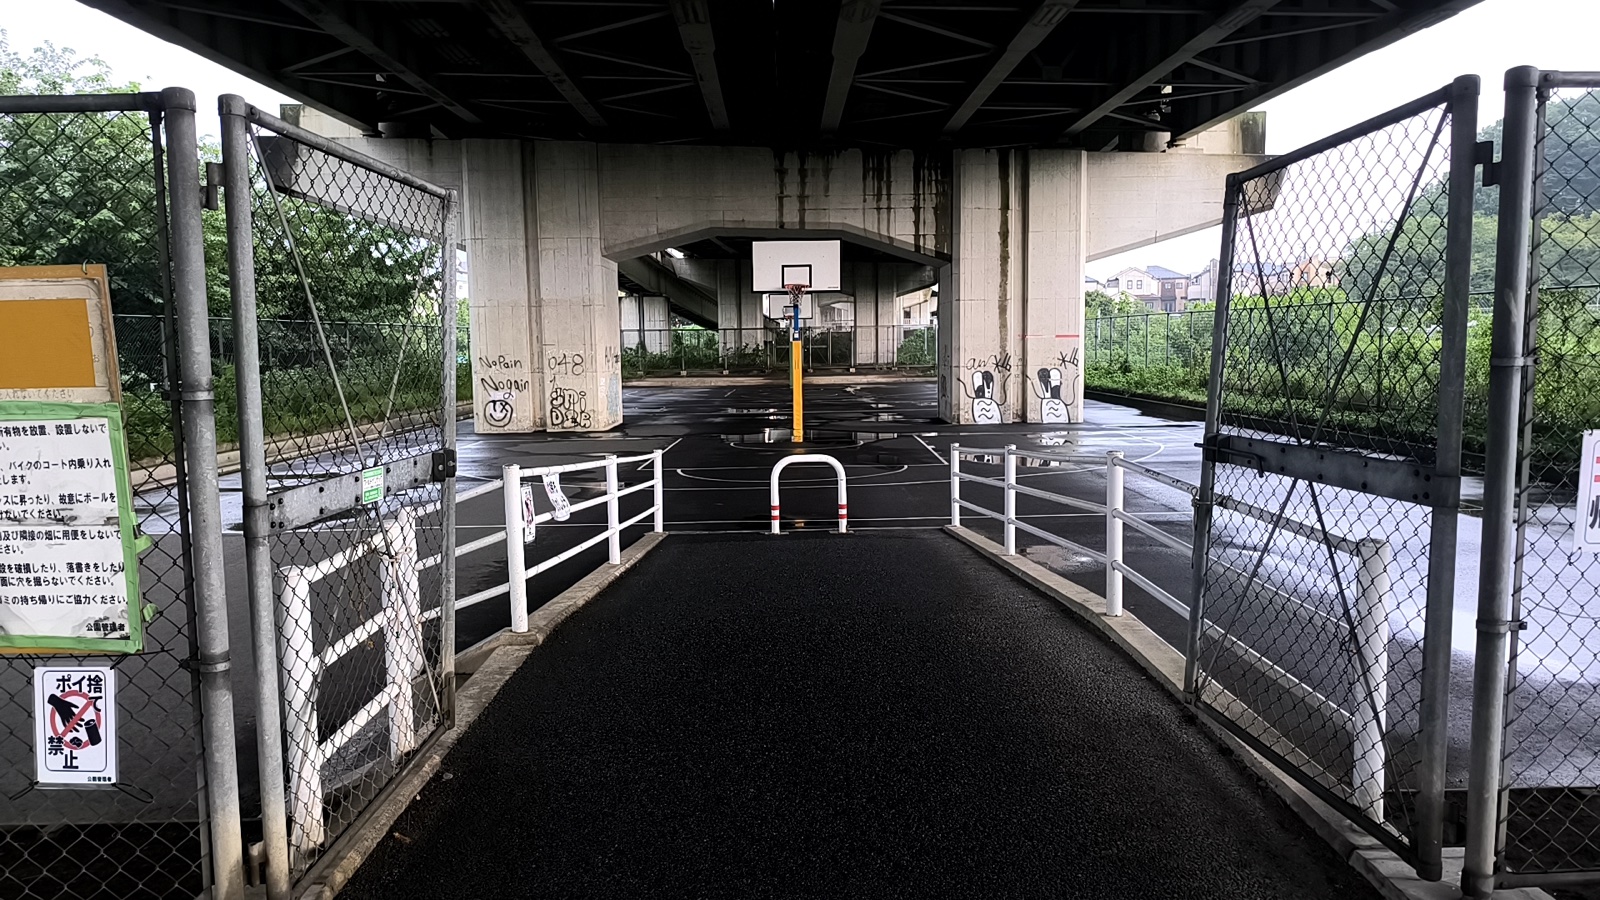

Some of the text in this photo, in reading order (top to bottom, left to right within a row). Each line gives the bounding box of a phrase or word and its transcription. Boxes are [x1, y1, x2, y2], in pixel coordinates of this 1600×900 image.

[0, 474, 31, 485] します。
[0, 492, 116, 506] スに昇ったり、故意にボールを
[0, 529, 121, 541] 及び隣接の畑に用便をしないで
[0, 595, 128, 606] ミの持ち帰りにご協力ください。
[56, 674, 103, 712] ポイ捨て
[48, 735, 79, 769] 禁止
